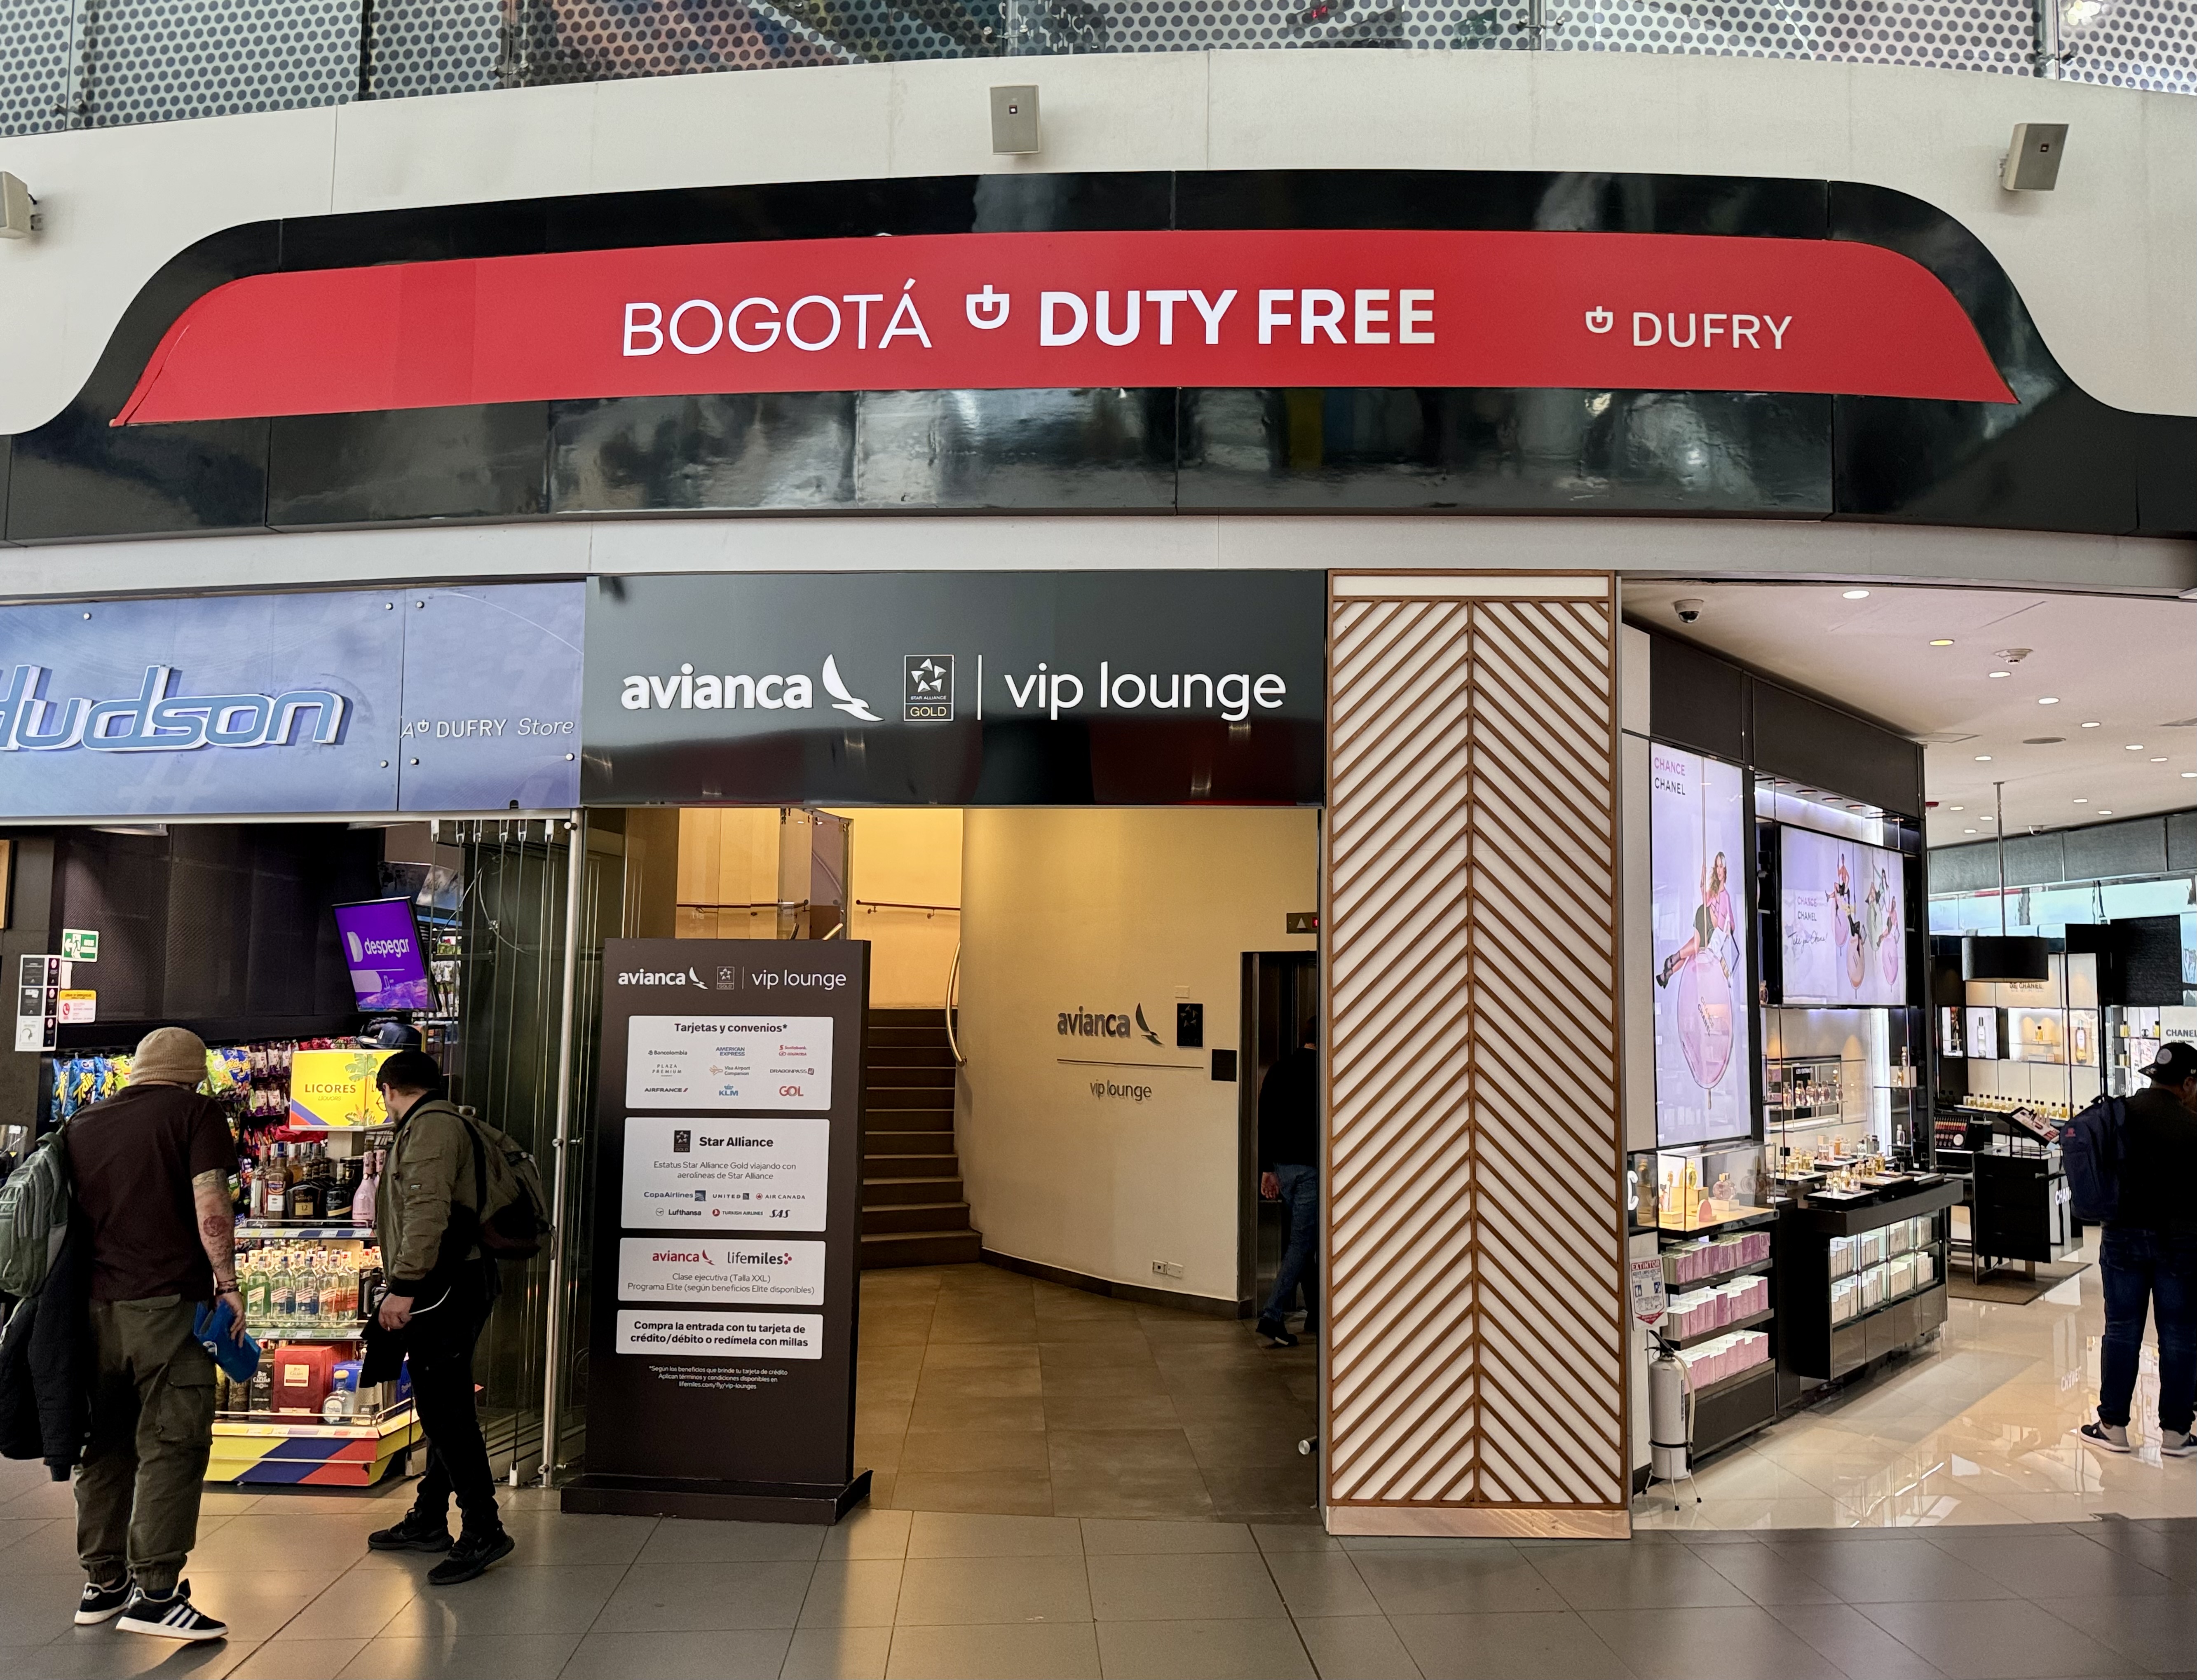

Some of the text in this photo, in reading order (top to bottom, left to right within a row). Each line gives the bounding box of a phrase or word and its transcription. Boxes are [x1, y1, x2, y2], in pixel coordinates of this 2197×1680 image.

[623, 278, 1435, 356] BOGOTÁ DUTY FREE
[1633, 312, 1793, 349] DUFRY
[621, 663, 814, 710] avianca
[1004, 661, 1287, 722] vip lounge
[910, 706, 947, 717] GOLD
[436, 719, 508, 738] DUFRY
[518, 718, 574, 736] Store
[1654, 757, 1686, 776] CHANCE
[1655, 777, 1686, 796] CHANEL
[1797, 896, 1817, 907] CHANCE
[1797, 911, 1817, 922] CHANEL
[364, 937, 410, 958] despegar
[618, 968, 686, 986] avianca
[752, 969, 847, 991] vip lounge
[674, 1022, 717, 1033] Tarjetas
[720, 1025, 726, 1034] y
[1057, 1005, 1131, 1038] avianca
[2166, 1029, 2197, 1037] CHANEL
[305, 1084, 356, 1093] LICORES
[779, 1086, 804, 1097] GOL
[1090, 1080, 1153, 1101] vip lounge
[699, 1136, 774, 1147] Star Alliance
[750, 1162, 781, 1171] viajando
[769, 1209, 791, 1218] SAS
[652, 1250, 700, 1262] avianca
[727, 1251, 783, 1265] lifemiles
[1632, 1260, 1660, 1270] EXTINTOR
[694, 1273, 728, 1283] ejecutiva
[729, 1274, 750, 1283] (Talla
[751, 1275, 771, 1284] XXL)
[628, 1283, 665, 1292] Programa
[684, 1284, 710, 1293] (según
[712, 1284, 750, 1293] beneficios
[769, 1285, 815, 1294] disponibles)
[634, 1321, 673, 1331] Compra
[675, 1322, 684, 1331] la
[686, 1322, 724, 1331] entrada
[746, 1324, 757, 1332] tu
[759, 1324, 791, 1334] tarjeta
[793, 1325, 806, 1333] de
[630, 1333, 704, 1344] crédito/débito
[714, 1335, 757, 1345] redímela
[779, 1337, 808, 1347] millas
